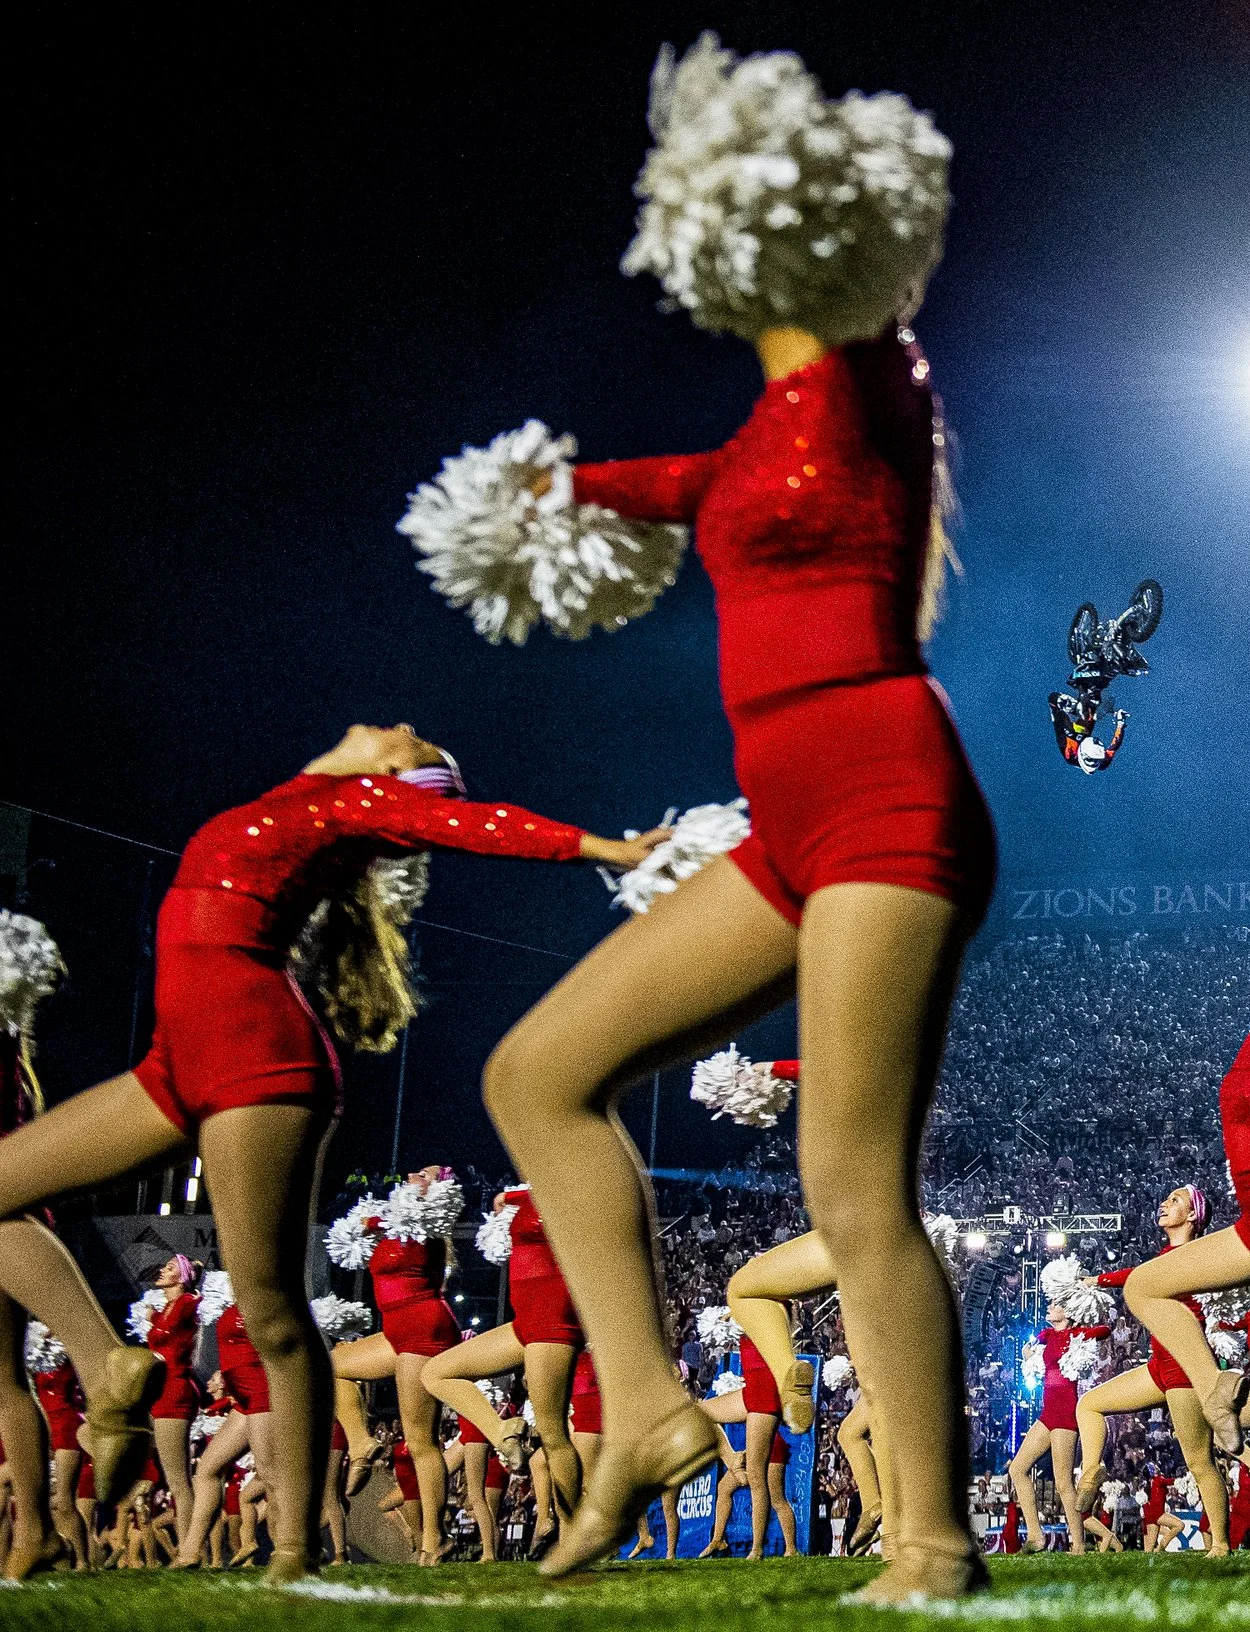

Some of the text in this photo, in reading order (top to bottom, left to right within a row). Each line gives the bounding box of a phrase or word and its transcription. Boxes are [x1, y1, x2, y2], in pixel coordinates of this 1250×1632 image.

[1012, 887, 1137, 919] ZIONS
[679, 1474, 711, 1498] NITRO
[677, 1494, 713, 1520] CIRCUS
